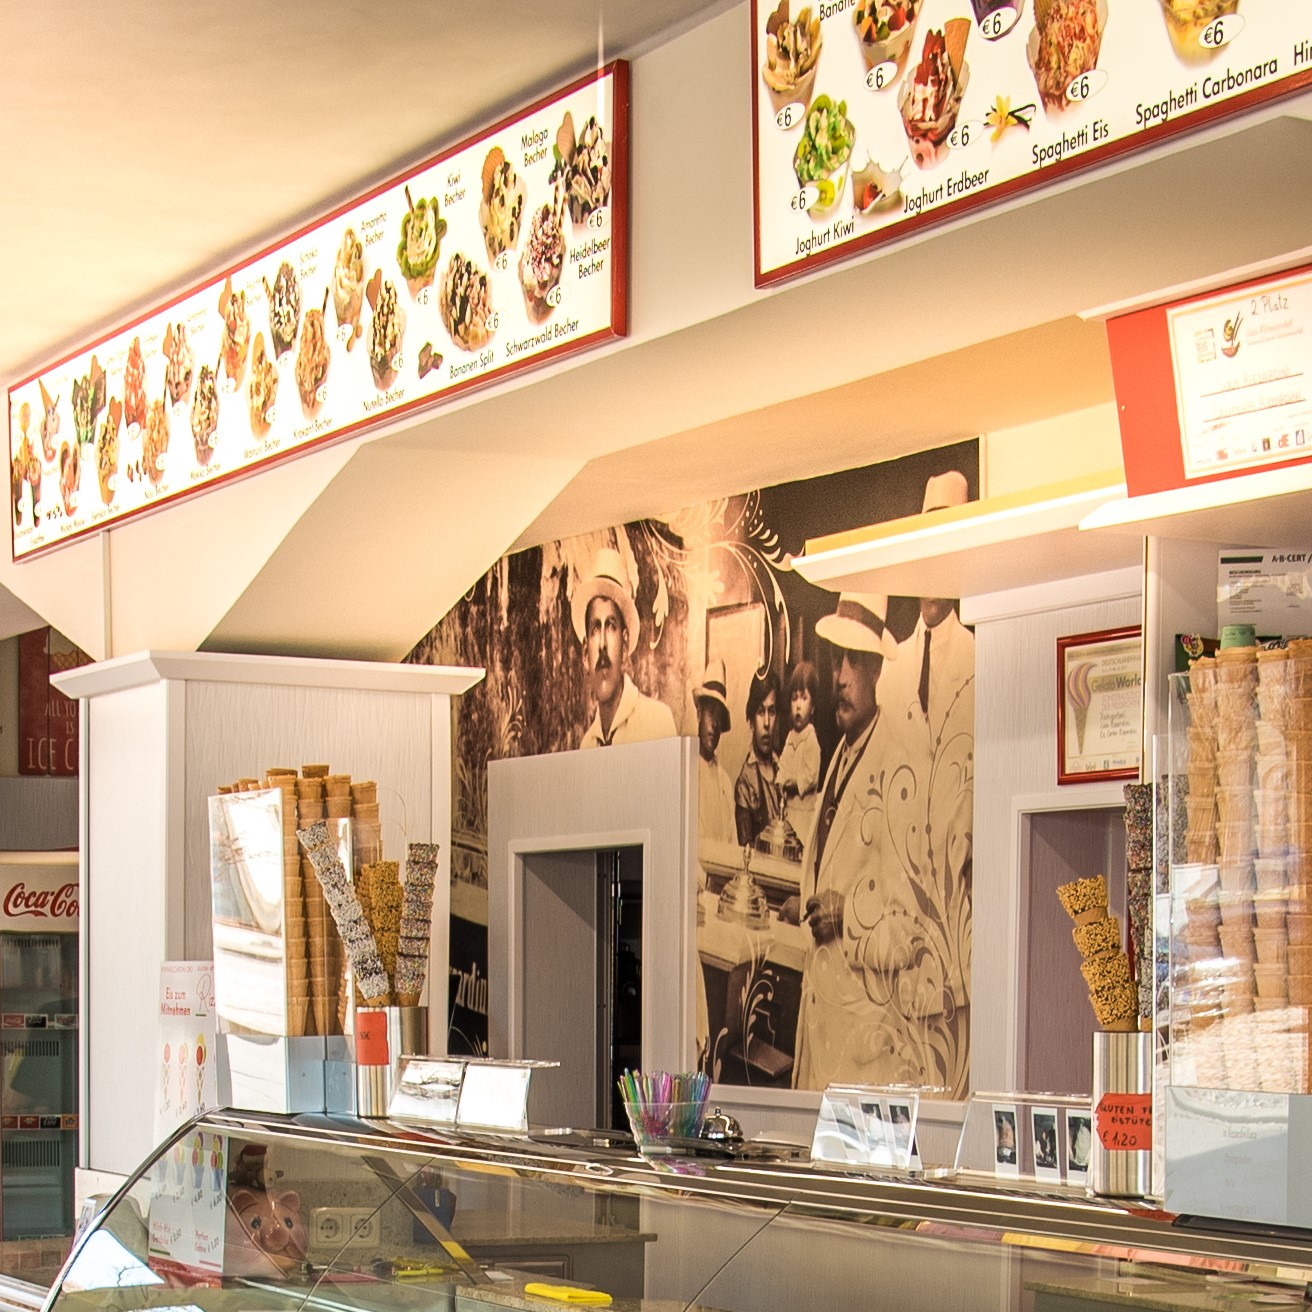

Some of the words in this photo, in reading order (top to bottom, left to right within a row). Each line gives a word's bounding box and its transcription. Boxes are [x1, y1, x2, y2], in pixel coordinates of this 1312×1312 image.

[1136, 83, 1197, 130] Spaghetti
[1202, 57, 1277, 98] Carbonara
[521, 128, 548, 151] Malaga
[1033, 126, 1088, 168] Spaghetti
[1093, 120, 1109, 141] Eis
[524, 146, 548, 167] Becher
[447, 168, 461, 187] Kiwi
[445, 187, 466, 207] Becher
[904, 186, 943, 215] Joghurt
[947, 170, 989, 197] Erdbeer
[361, 213, 386, 232] Amaretto
[366, 230, 384, 247] Becher
[796, 226, 830, 256] Joghurt
[833, 216, 854, 239] Kiwi
[570, 235, 610, 264] Heidelbeer
[579, 259, 603, 279] Becher
[1263, 294, 1288, 313] Platz
[506, 324, 552, 358] Schwarzwald
[554, 318, 579, 339] Becher
[450, 358, 478, 379] Bananen
[480, 351, 494, 368] Split
[386, 387, 404, 406] Becher
[45, 700, 61, 717] ALL
[64, 701, 79, 718] YO
[66, 722, 74, 734] IS
[27, 738, 56, 770] ICE
[65, 739, 79, 770] C
[1100, 1103, 1134, 1114] GLUTEN
[1112, 1133, 1137, 1146] 1,20
